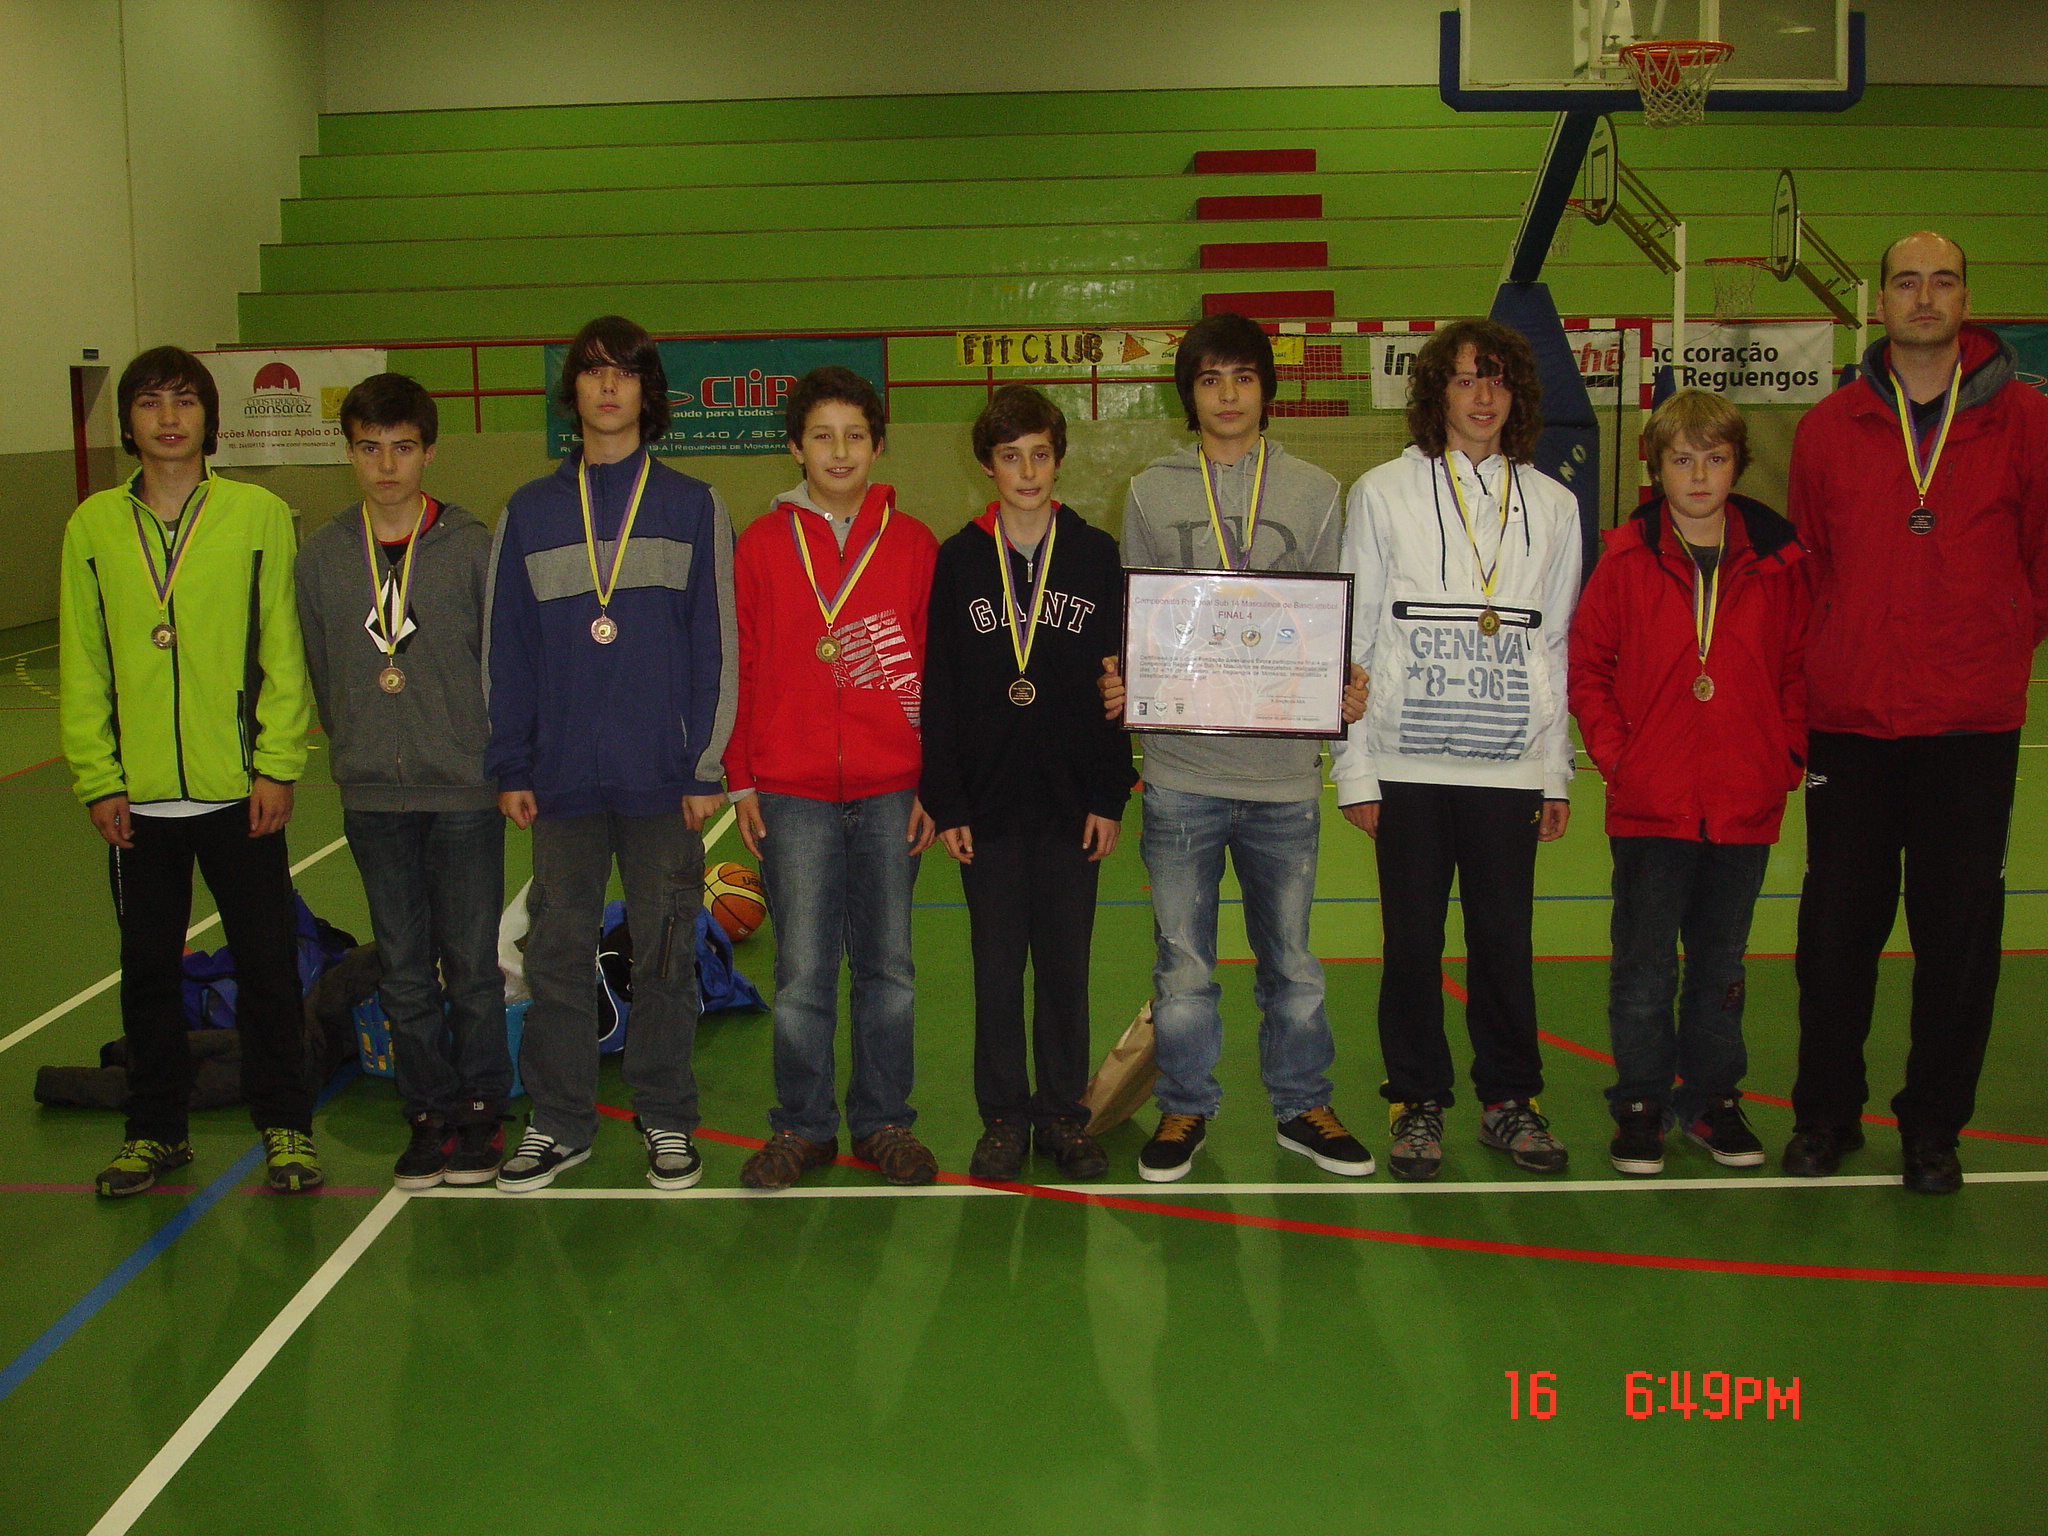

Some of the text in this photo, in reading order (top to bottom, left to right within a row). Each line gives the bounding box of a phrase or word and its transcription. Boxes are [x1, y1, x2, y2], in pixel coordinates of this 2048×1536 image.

[962, 332, 1104, 365] FIT CLUB
[1384, 344, 1417, 376] In
[1683, 345, 1779, 372] coração
[1684, 366, 1819, 392] Reguengos
[244, 404, 312, 415] monsaraz
[673, 409, 774, 420] aúde para todos
[217, 429, 245, 440] uções
[247, 429, 292, 438] Monsaraz
[294, 427, 321, 438] Apoia
[324, 428, 331, 436] o
[558, 433, 582, 443] TE
[693, 430, 730, 440] 440
[968, 589, 1096, 634] GANT
[1218, 611, 1253, 619] FINAL 4
[1241, 600, 1281, 608] Masculinos
[1409, 626, 1526, 667] GENEVA
[1425, 664, 1505, 701] 8-96
